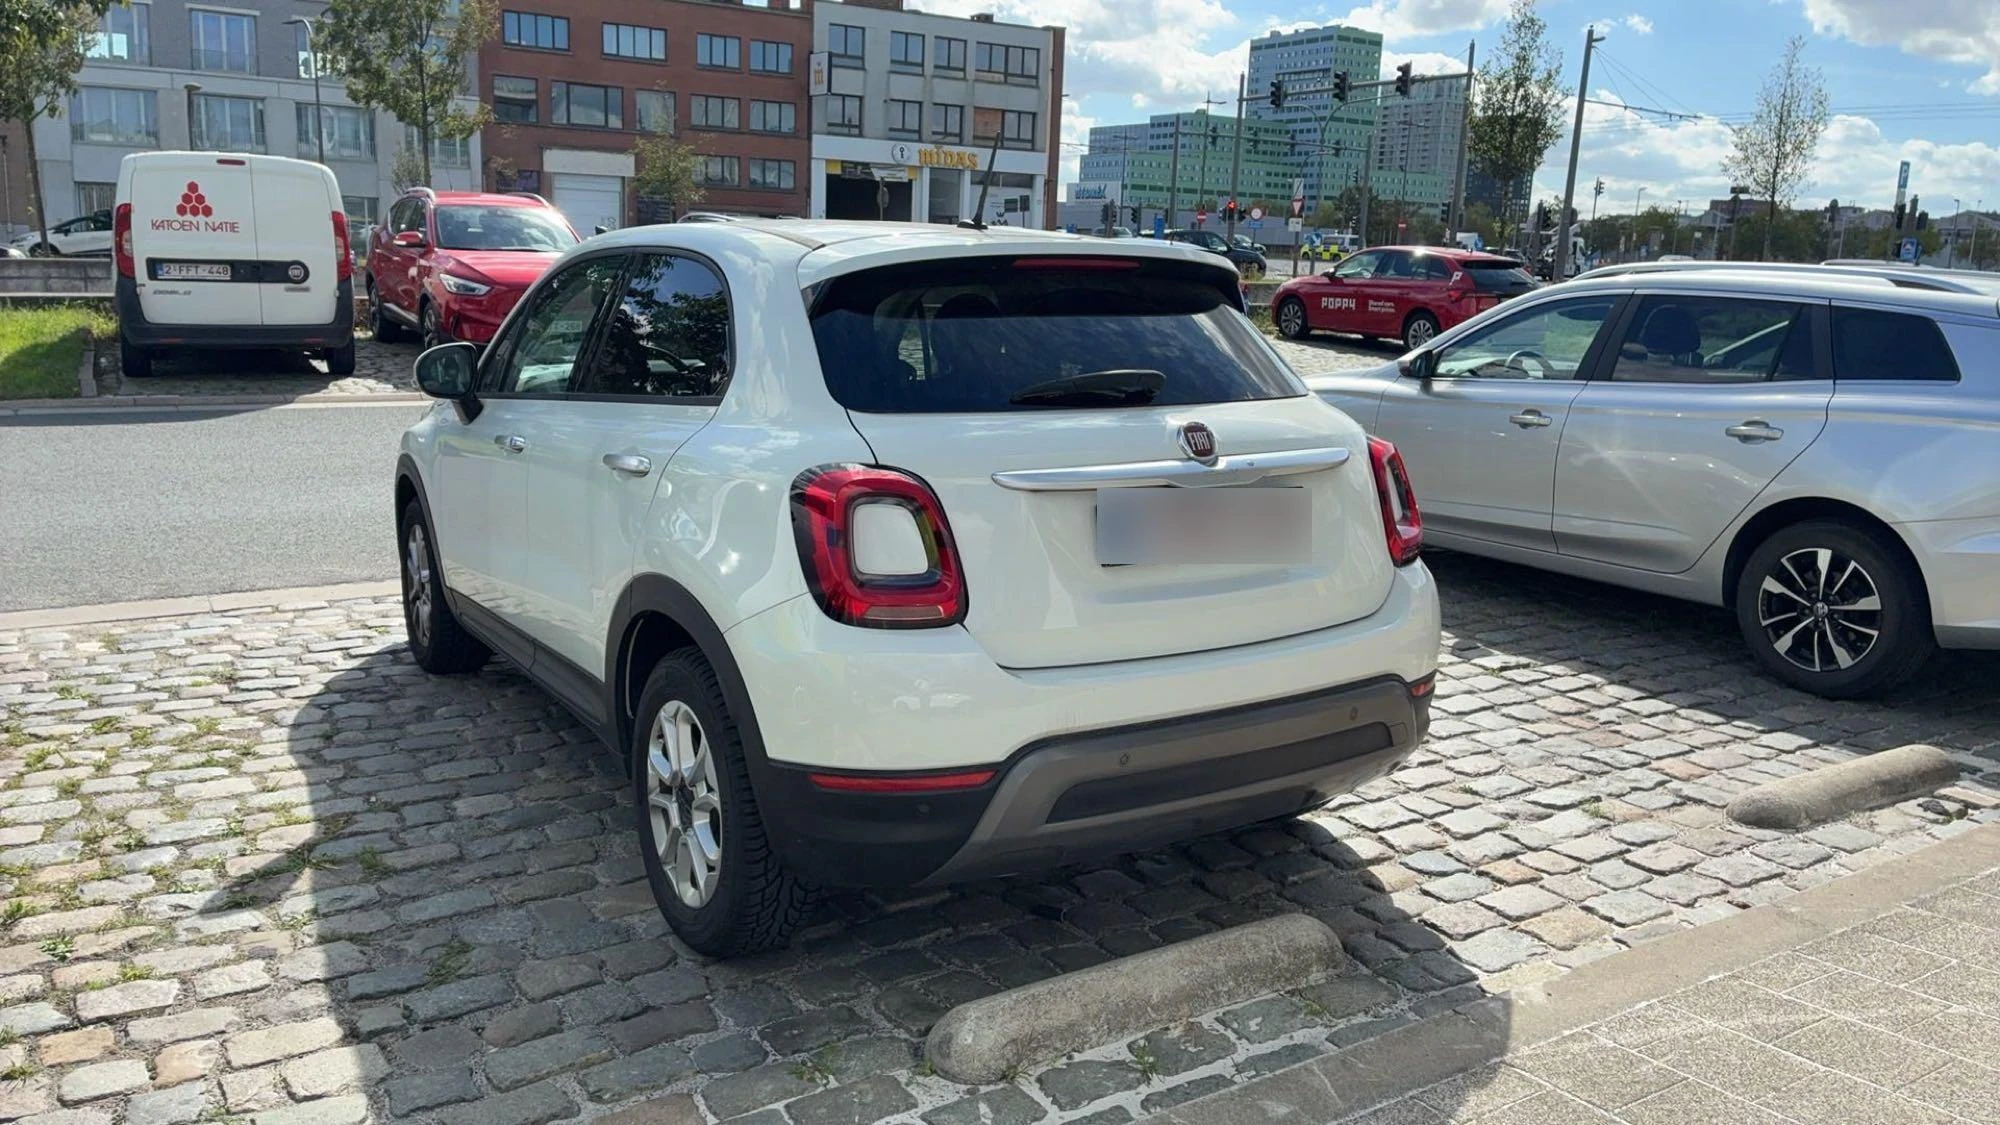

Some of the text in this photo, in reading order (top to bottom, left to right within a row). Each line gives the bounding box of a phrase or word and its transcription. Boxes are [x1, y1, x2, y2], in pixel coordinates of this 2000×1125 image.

[151, 219, 240, 233] KATOEN NATIE
[1321, 297, 1356, 311] POPPY
[1188, 432, 1210, 450] FIAT
